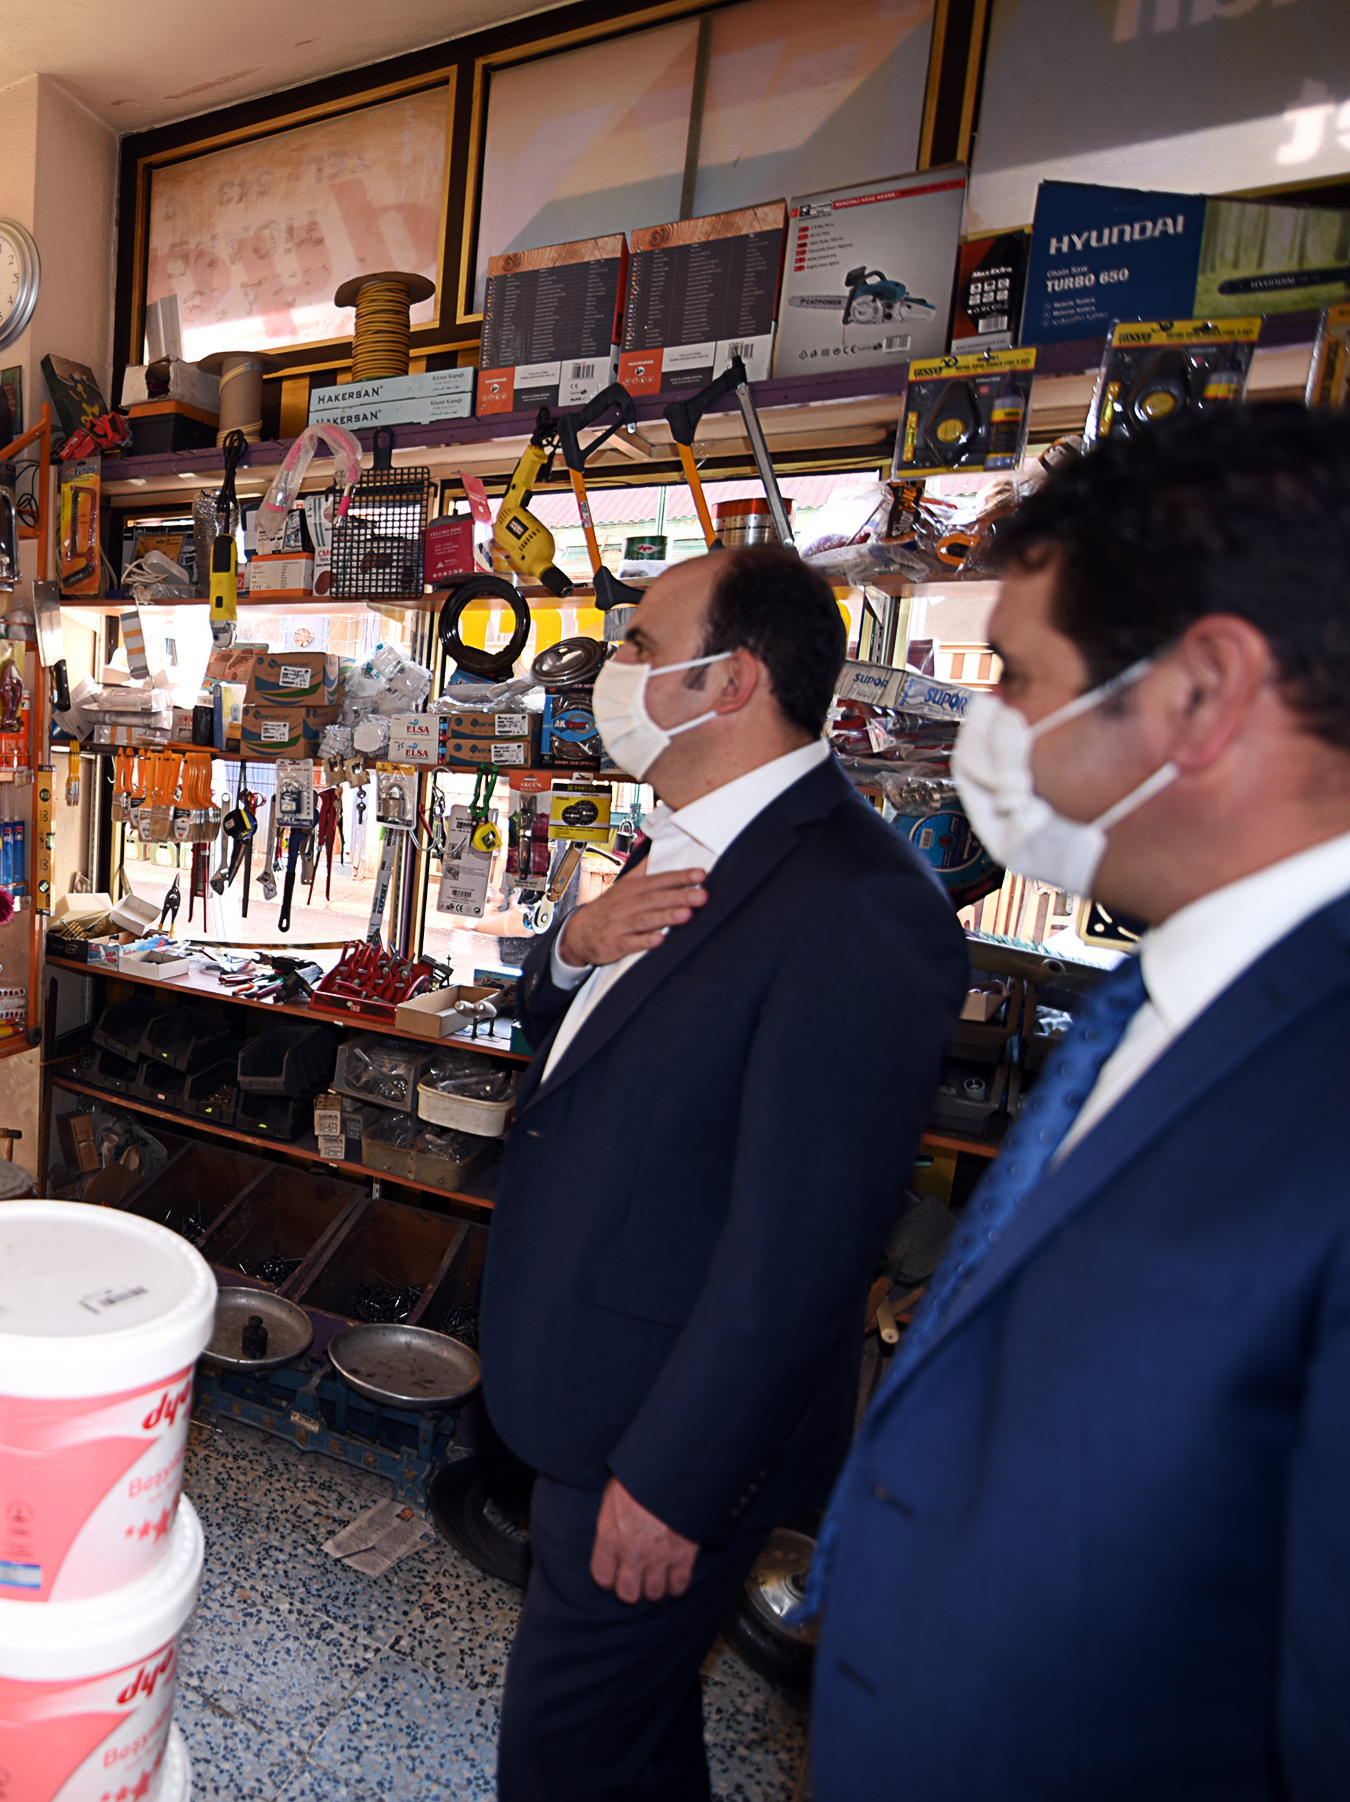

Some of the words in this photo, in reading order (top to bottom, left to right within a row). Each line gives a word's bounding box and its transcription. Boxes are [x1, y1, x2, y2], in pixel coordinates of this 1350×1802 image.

[1050, 214, 1185, 255] HYUNDAI
[8, 254, 14, 266] 2
[990, 266, 1012, 275] Extra
[1047, 268, 1069, 278] Chain
[1071, 265, 1088, 274] Saw
[12, 273, 19, 284] 3
[1046, 273, 1096, 293] TURBO
[1099, 268, 1130, 285] 650
[7, 295, 13, 305] 4
[317, 386, 380, 405] HAKERSAN
[316, 410, 379, 425] KERSAN
[74, 466, 96, 475] ELTOS
[852, 671, 889, 690] SUPOR
[923, 687, 969, 716] SUPOR
[406, 725, 430, 734] ELSA
[554, 719, 567, 728] AK
[405, 749, 429, 758] ELSA
[377, 883, 388, 914] EXPERT
